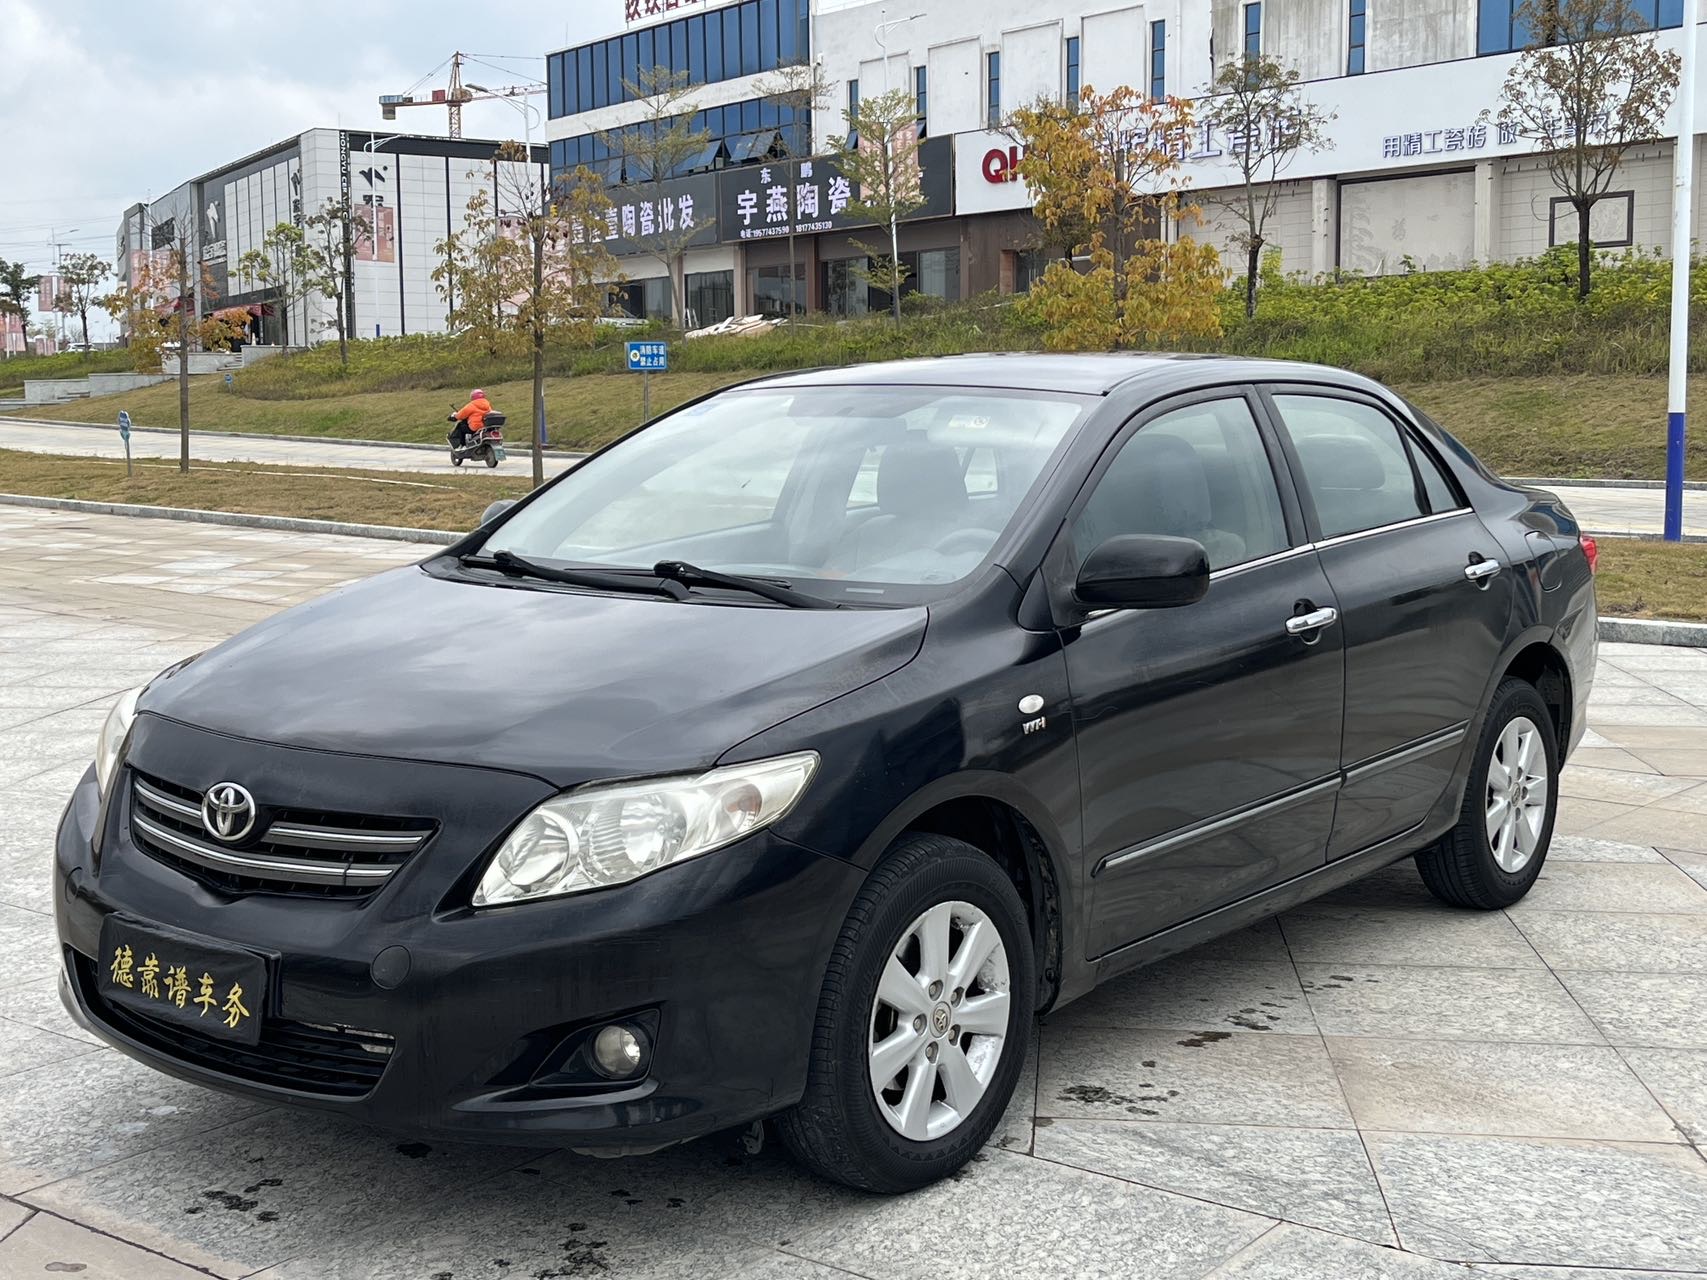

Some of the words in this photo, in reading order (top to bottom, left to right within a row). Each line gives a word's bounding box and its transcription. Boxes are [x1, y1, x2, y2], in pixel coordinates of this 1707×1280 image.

[1383, 126, 1487, 158] 用精工瓷砖
[110, 944, 250, 1029] 德靠谱车务
